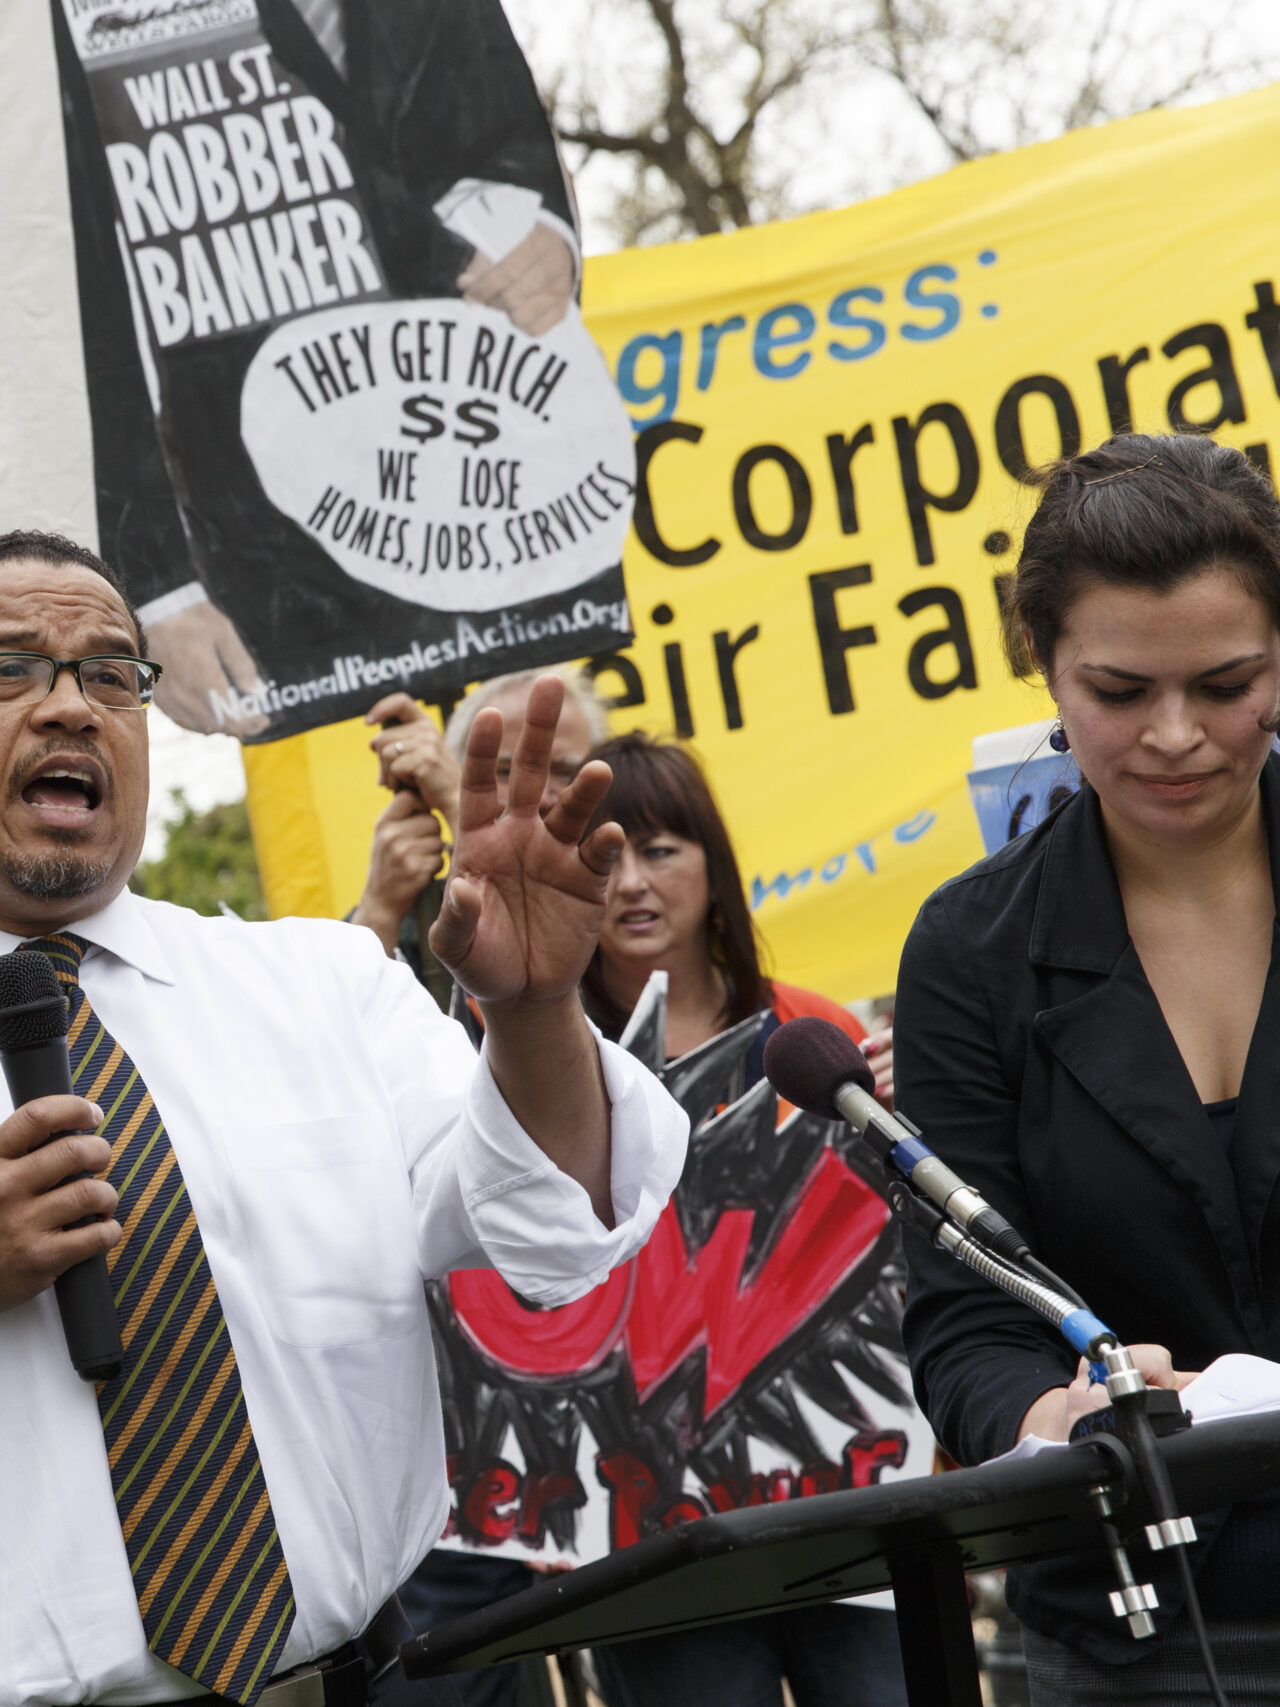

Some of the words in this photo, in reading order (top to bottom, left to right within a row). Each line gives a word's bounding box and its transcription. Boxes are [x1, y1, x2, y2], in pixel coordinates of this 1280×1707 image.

[123, 58, 232, 130] WALL
[228, 43, 292, 106] ST.
[105, 95, 354, 244] ROBBER
[134, 198, 382, 348] BANKER
[274, 325, 378, 413] THEY
[391, 319, 457, 384] GET
[467, 327, 568, 422] RICH.
[308, 485, 413, 572] HOMES,
[420, 521, 503, 576] JOBS,
[504, 460, 636, 565] SERVICES
[378, 448, 418, 503] WE
[461, 456, 523, 511] LOSE
[207, 598, 628, 729] NationalPeoplesAction.Org
